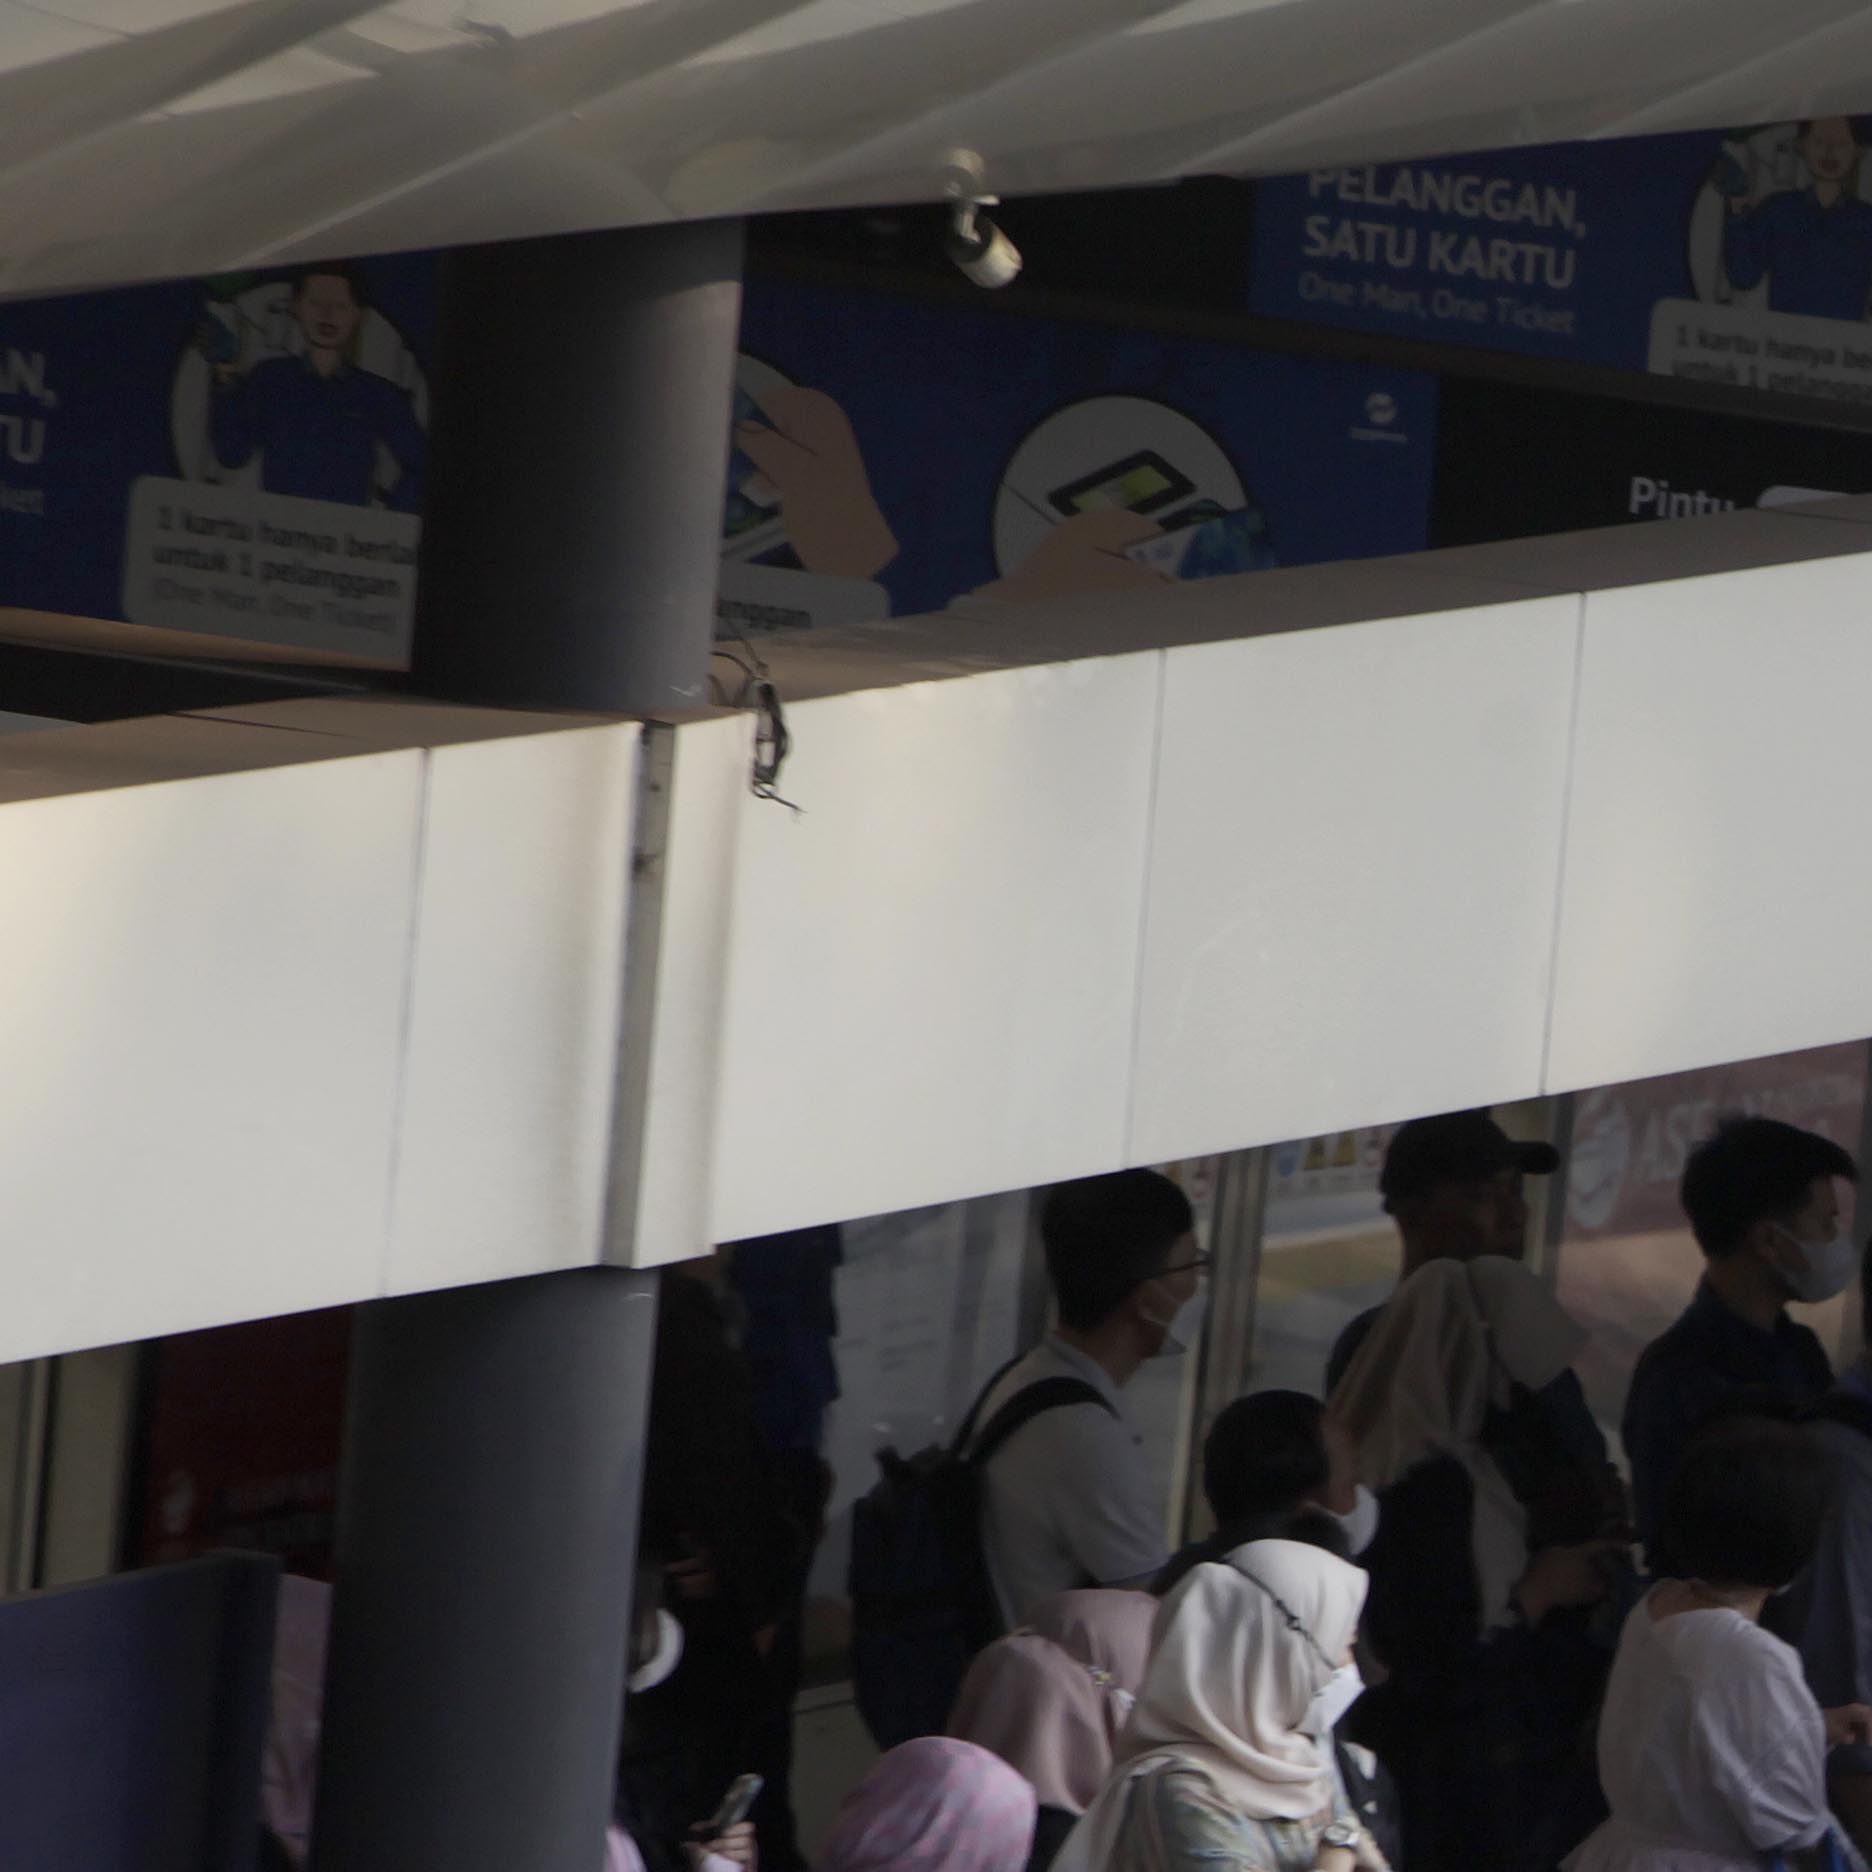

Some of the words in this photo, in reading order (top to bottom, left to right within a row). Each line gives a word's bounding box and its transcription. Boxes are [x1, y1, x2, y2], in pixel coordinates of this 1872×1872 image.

[1303, 214, 1418, 269] SATU
[1427, 230, 1576, 289] KARTU
[1299, 270, 1356, 305] One
[1430, 286, 1490, 323] One
[1494, 296, 1576, 335] Ticket
[1697, 327, 1758, 355] kartu
